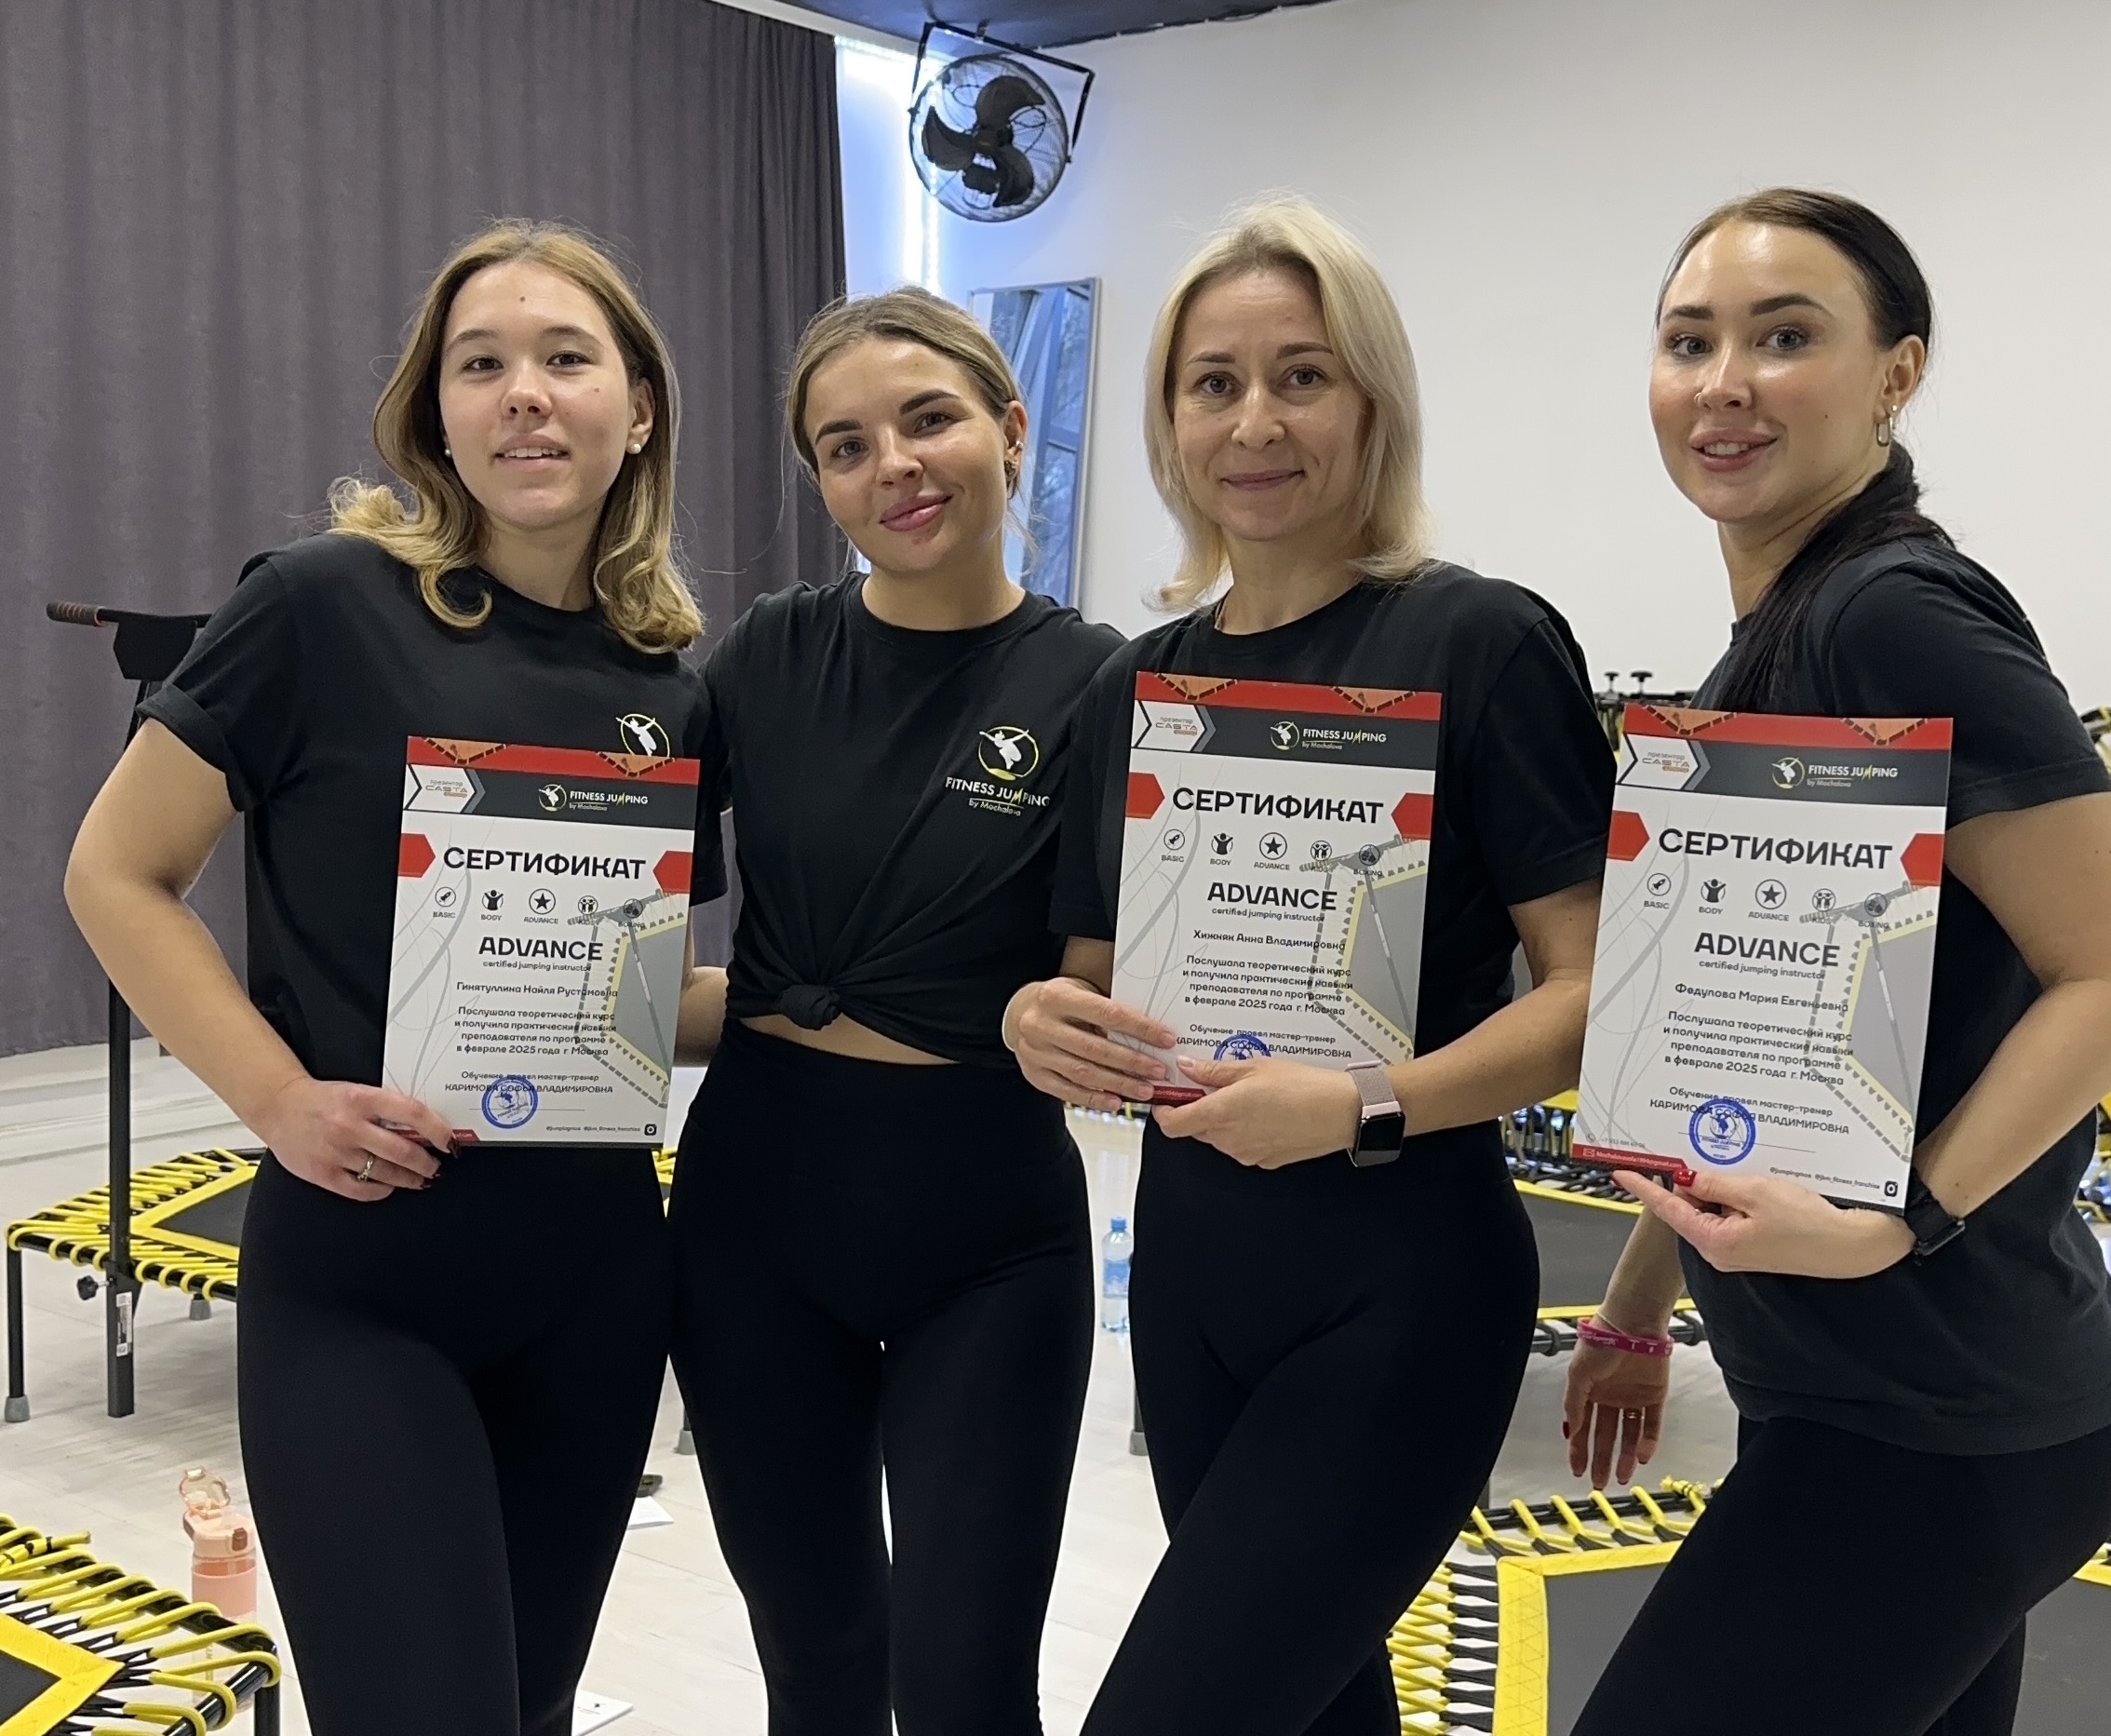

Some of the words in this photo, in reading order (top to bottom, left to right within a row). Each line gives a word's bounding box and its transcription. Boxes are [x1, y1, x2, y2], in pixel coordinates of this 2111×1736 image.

[1303, 728, 1340, 739] FITNESS
[1341, 730, 1387, 743] JUMPING
[1808, 765, 1849, 776] FITNESS
[1850, 764, 1899, 780] JUMPING
[570, 790, 605, 801] FITNESS
[607, 791, 648, 806] JUMPING
[946, 776, 995, 795] FITNESS
[996, 787, 1050, 806] JUMPING
[968, 799, 979, 808] by
[1172, 787, 1384, 824] СЕРТИФИКАТ
[1658, 827, 1893, 870] СЕРТИФИКАТ
[443, 846, 646, 880] СЕРТИФИКАТ
[1162, 855, 1184, 863] BASIC
[1254, 862, 1290, 871] ADVANCE
[1207, 882, 1338, 911] ADVANCE
[523, 916, 558, 925] ADVANCE
[1212, 907, 1247, 917] certified
[1247, 908, 1282, 922] jumping
[1284, 912, 1325, 923] instructor
[1644, 900, 1670, 910] BASIC
[1699, 907, 1724, 915] BODY
[1748, 910, 1789, 922] ADVANCE
[478, 936, 603, 961] ADVANCE
[1193, 929, 1234, 943] Хижняк
[1236, 933, 1264, 944] Анна
[1266, 935, 1346, 951] Владимировна
[1694, 931, 1840, 966] ADVANCE
[483, 961, 518, 970] certified
[518, 962, 551, 972] jumping
[552, 963, 592, 972] instructor
[1187, 955, 1245, 971] Послушала
[1247, 962, 1325, 976] теоретический
[1327, 966, 1351, 977] курс
[1699, 959, 1739, 972] certified
[1739, 962, 1778, 977] jumping
[1780, 968, 1825, 979] instructor
[1191, 970, 1239, 983] получила
[1241, 974, 1312, 987] практические
[1314, 980, 1353, 989] навыки
[456, 982, 521, 995] Гинятуллина
[523, 984, 555, 996] Найля
[558, 987, 618, 998] Рустамовна
[1190, 981, 1268, 997] преподавателя
[1270, 989, 1283, 998] по
[1284, 990, 1342, 1003] программе
[1675, 983, 1737, 1002] Федулова
[1739, 989, 1778, 1006] Мария
[1781, 994, 1849, 1013] Евгеньевна
[458, 1006, 516, 1020] Послушала
[518, 1010, 591, 1022] теоретический
[592, 1013, 615, 1023] курс
[1192, 995, 1236, 1009] феврале
[1238, 999, 1267, 1009] 2025
[1268, 1002, 1292, 1013] года
[1305, 1004, 1345, 1016] Москва
[463, 1020, 510, 1031] получила
[512, 1022, 580, 1033] практические
[581, 1024, 616, 1032] навыки
[1190, 1024, 1234, 1035] Обучение
[1270, 1031, 1337, 1044] мастер-тренер
[1668, 1010, 1735, 1029] Послушала
[1737, 1018, 1824, 1039] теоретический
[1826, 1030, 1852, 1043] курс
[462, 1032, 537, 1044] преподавателя
[553, 1035, 605, 1044] программе
[1672, 1027, 1728, 1044] получила
[1729, 1032, 1809, 1053] практические
[1812, 1044, 1854, 1056] навыки
[464, 1044, 506, 1056] феврале
[508, 1045, 536, 1054] 2025
[538, 1047, 560, 1057] года
[571, 1047, 609, 1056] Москва
[1270, 1044, 1351, 1058] ВЛАДИМИРОВНА
[1671, 1041, 1759, 1062] преподавателя
[1761, 1052, 1776, 1061] по
[1778, 1054, 1841, 1071] программе
[462, 1070, 504, 1081] Обучение
[1674, 1055, 1724, 1072] феврале
[1726, 1061, 1757, 1074] 2025
[1759, 1067, 1786, 1082] года
[1800, 1070, 1845, 1086] Москва
[445, 1083, 499, 1093] КАРИМОВА
[537, 1085, 612, 1094] ВЛАДИМИРОВНА
[1669, 1085, 1718, 1104] Обучение
[1722, 1095, 1758, 1106] провел
[1759, 1100, 1833, 1118] мастер-тренер
[1649, 1098, 1714, 1116] КАРИМОВА
[1757, 1113, 1849, 1135] ВЛАДИМИРОВНА
